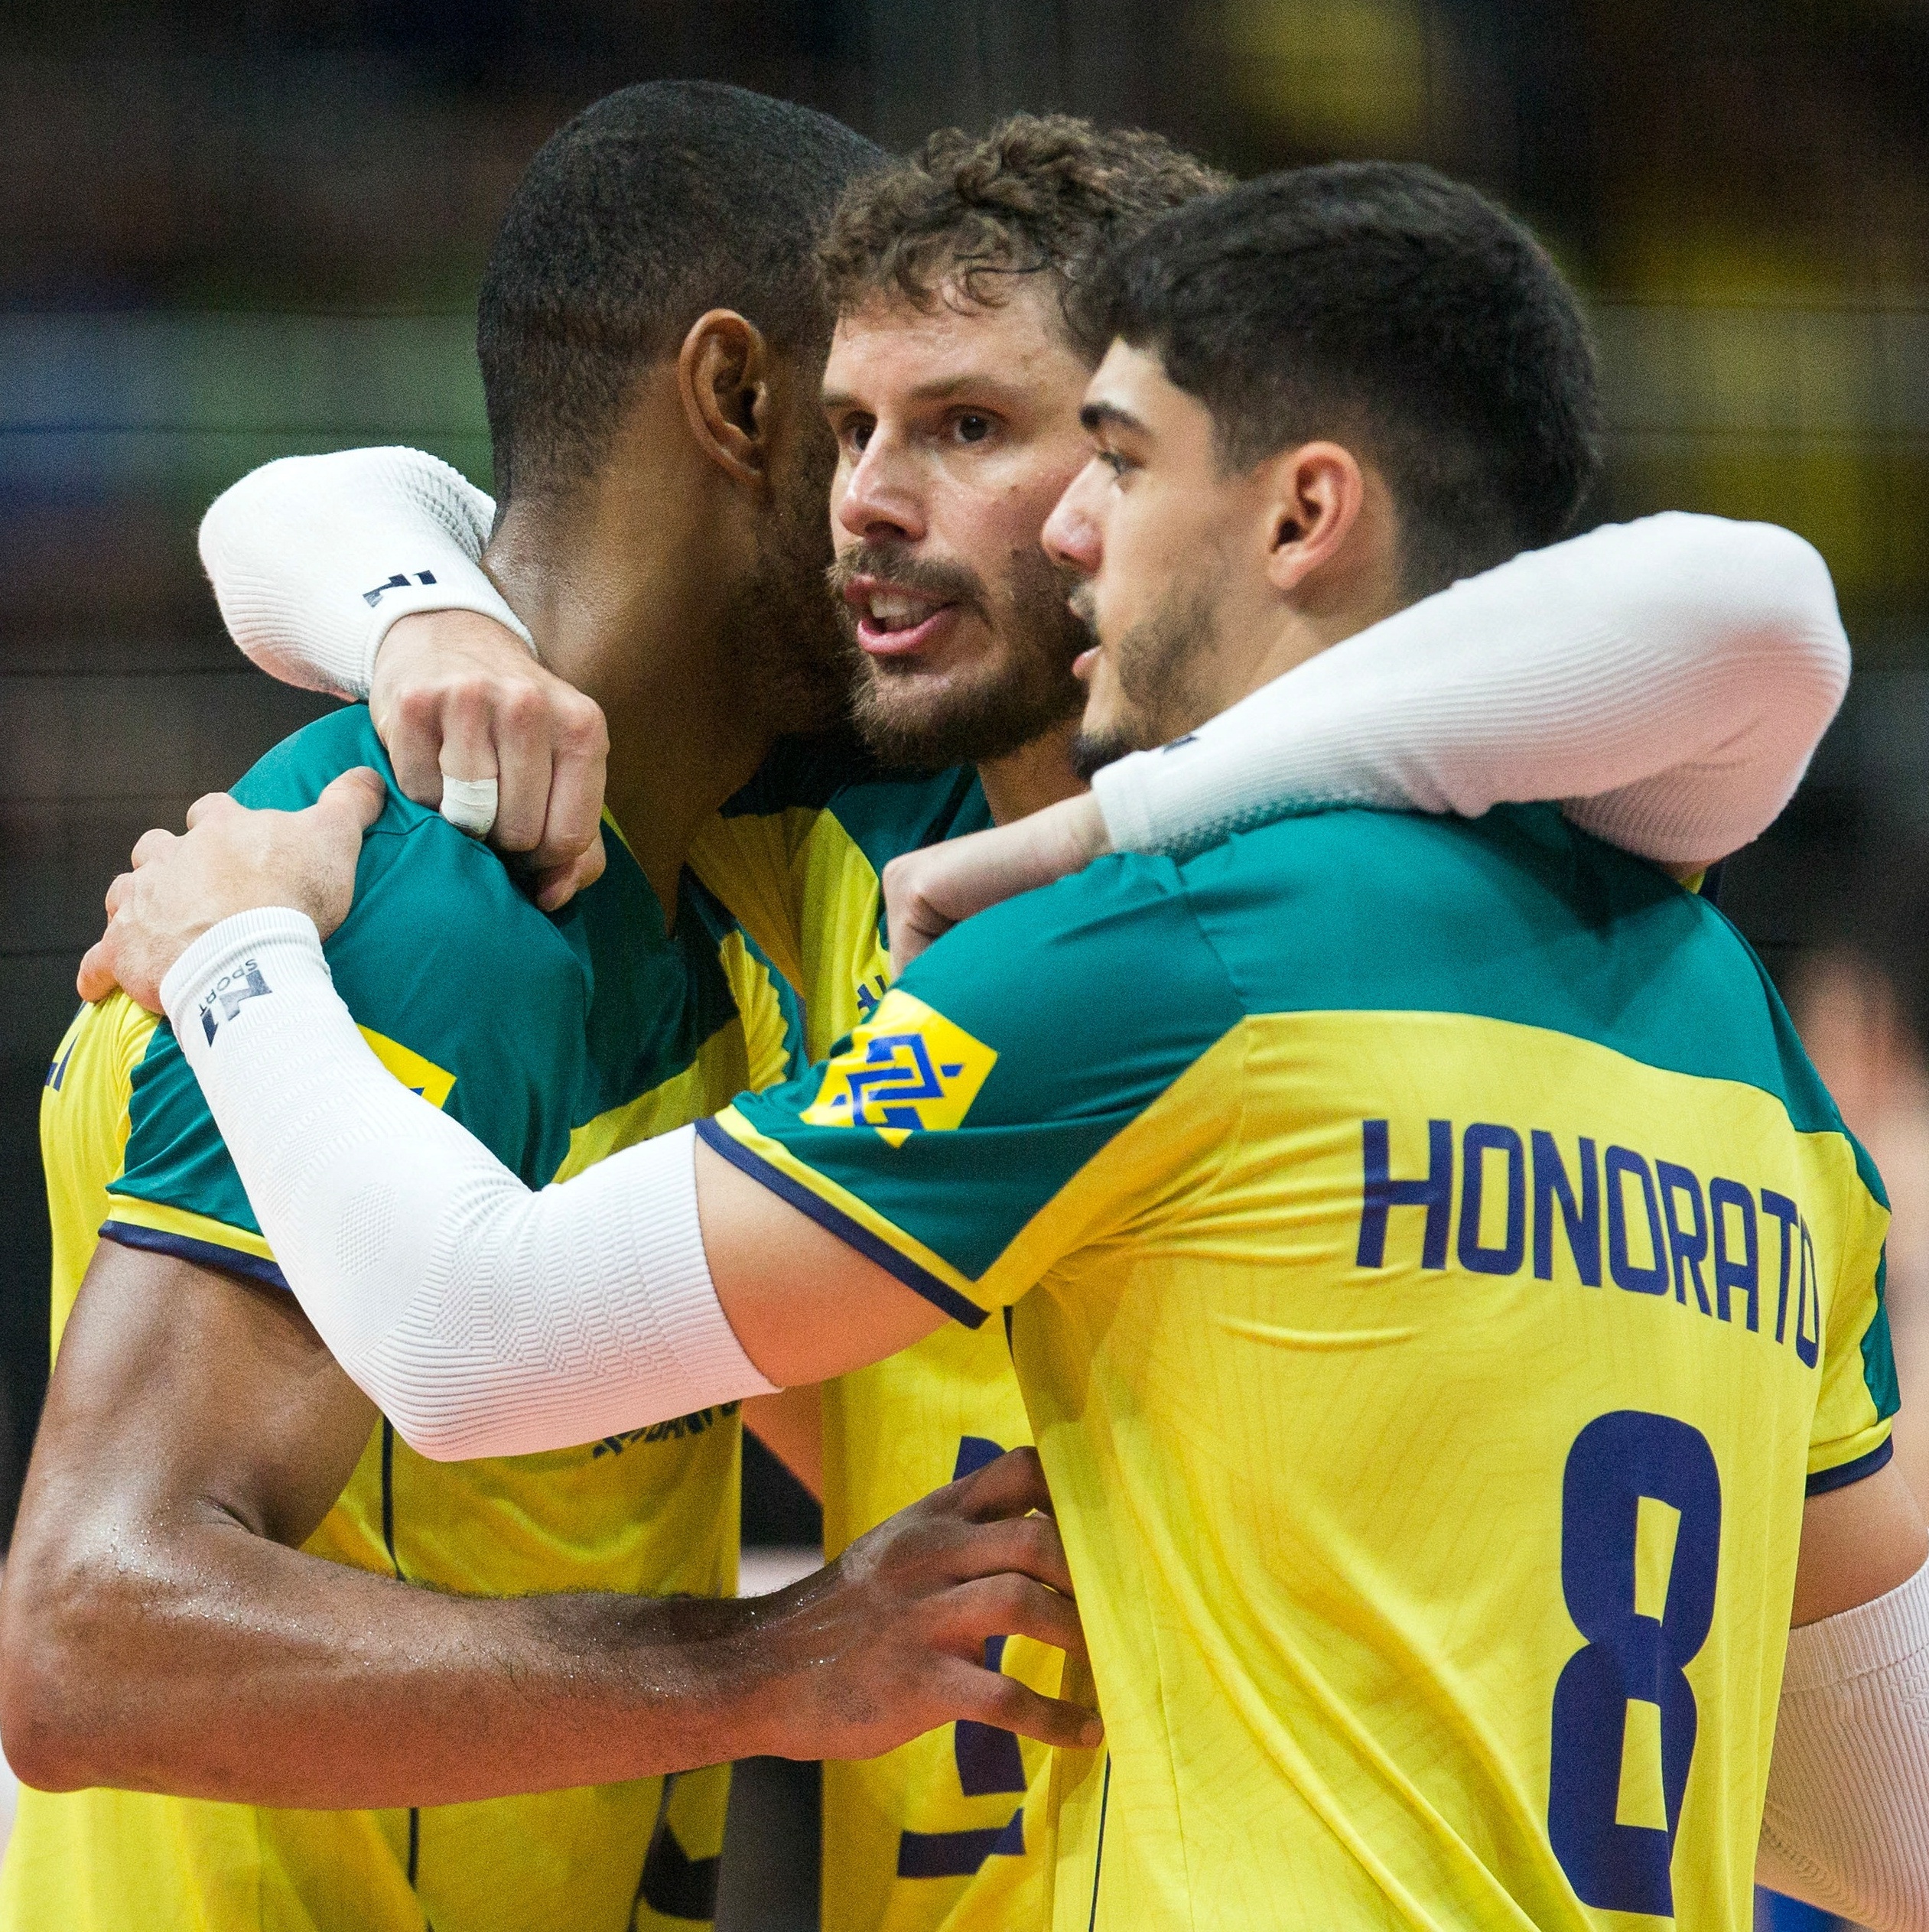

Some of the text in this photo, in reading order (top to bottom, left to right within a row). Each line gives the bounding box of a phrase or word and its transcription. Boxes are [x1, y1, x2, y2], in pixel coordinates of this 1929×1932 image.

[199, 958, 258, 1016] SPORT
[1356, 1119, 1820, 1369] HONORATO
[1547, 1410, 1722, 1918] 8
